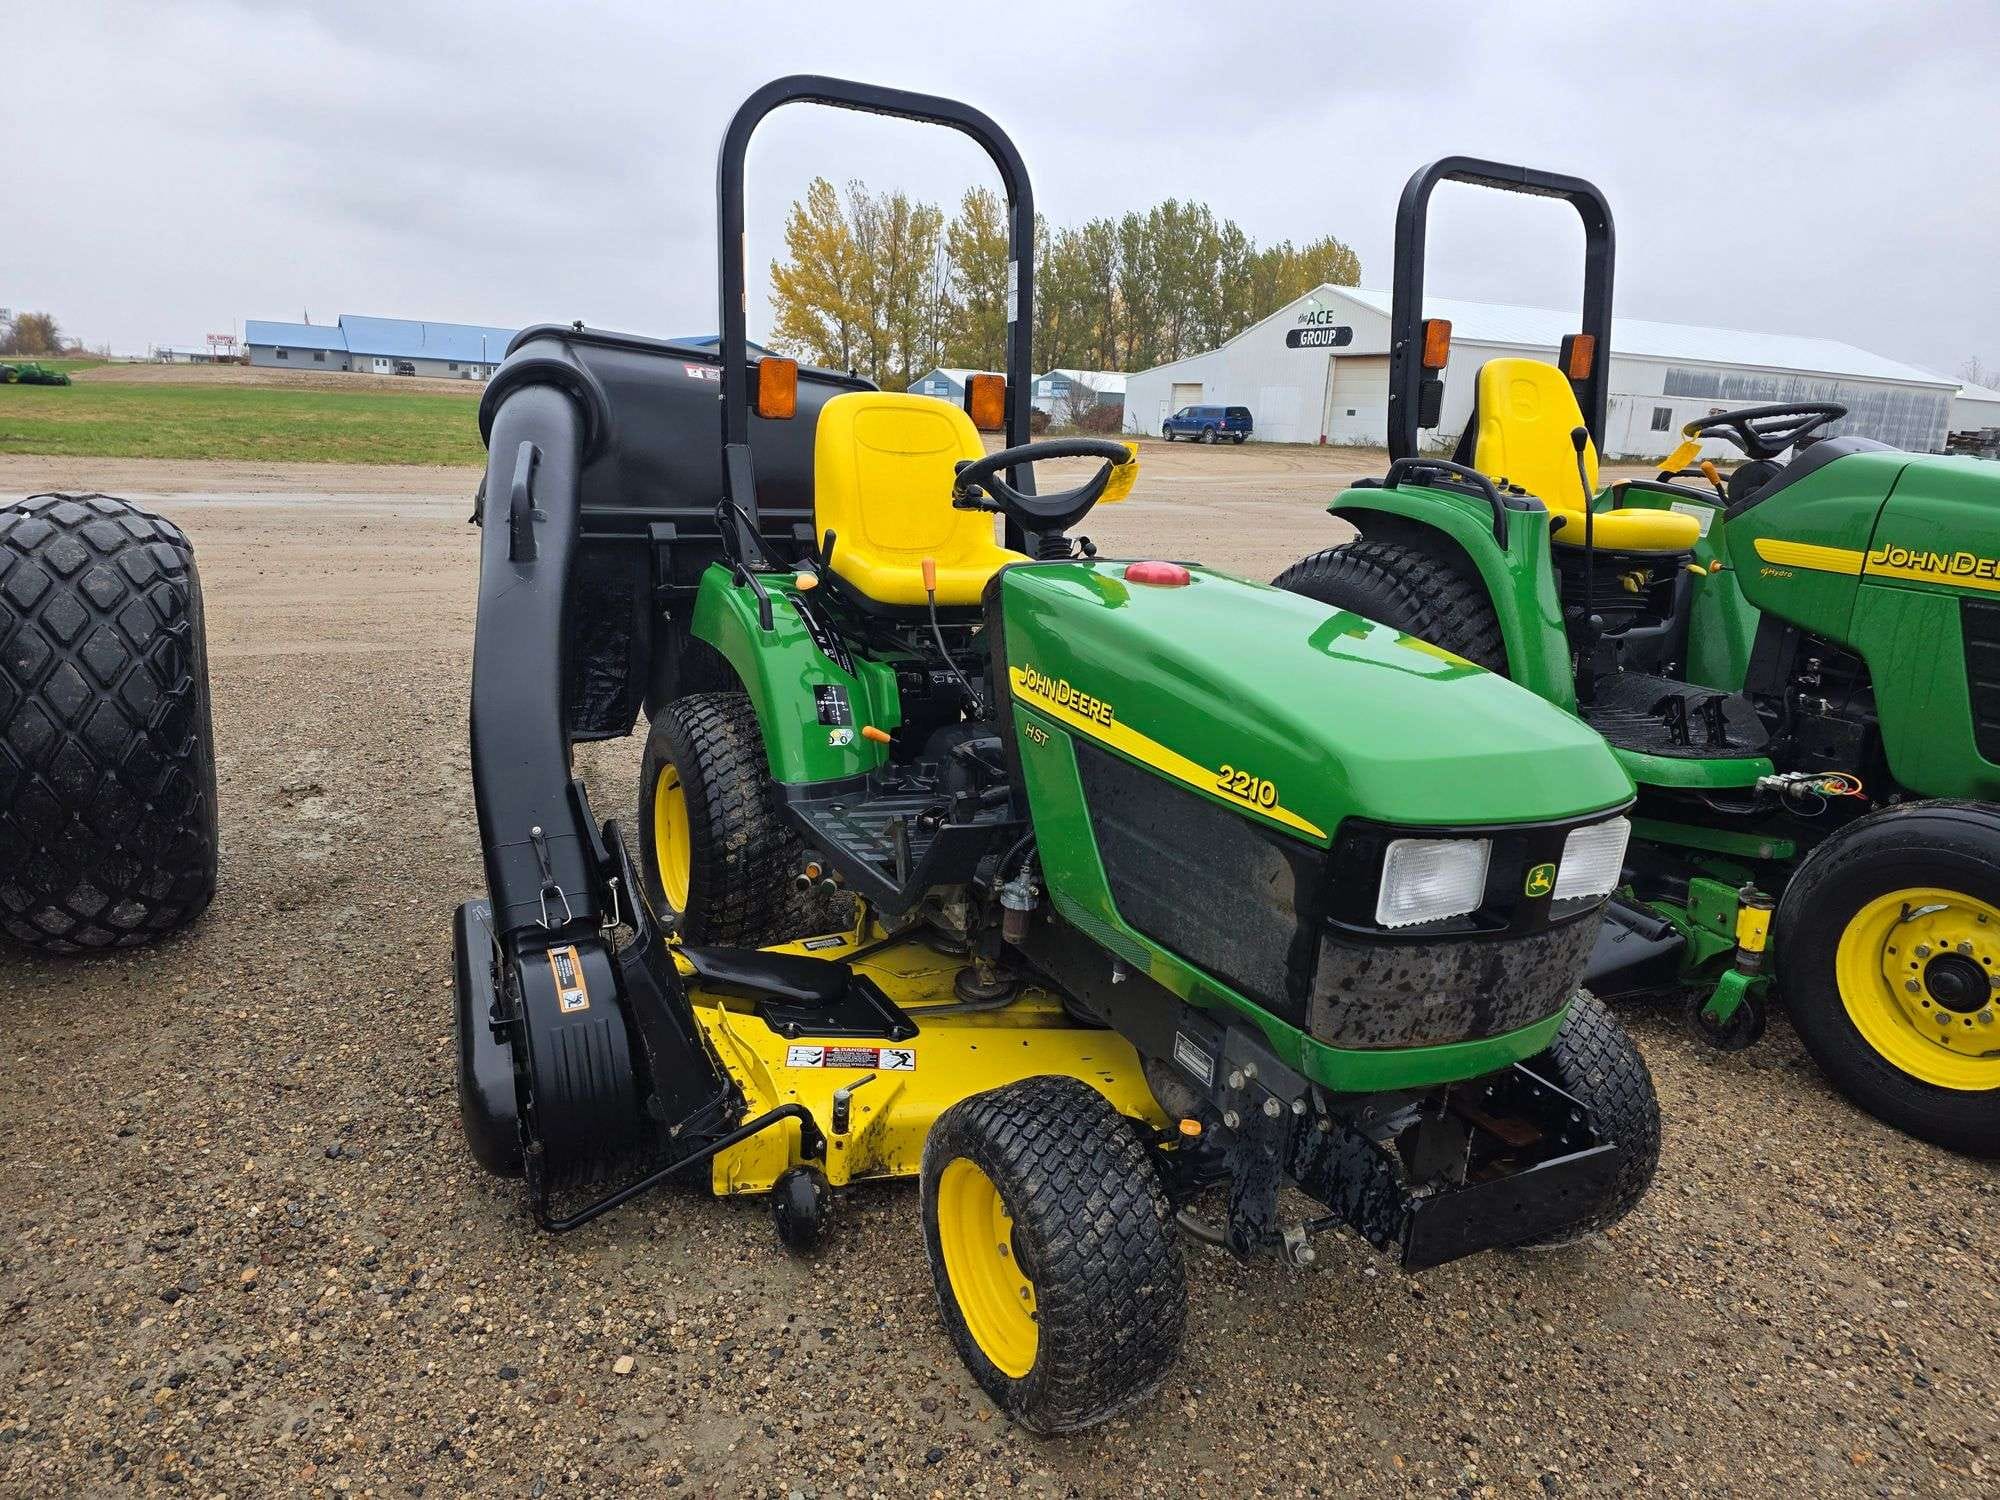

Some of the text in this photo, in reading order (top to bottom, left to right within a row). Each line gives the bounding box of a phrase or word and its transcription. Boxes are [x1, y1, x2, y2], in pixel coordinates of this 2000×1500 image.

[1307, 310, 1334, 326] ACE
[1300, 329, 1337, 346] GROUP
[1872, 543, 1950, 574] JOHN
[1020, 663, 1113, 727] JOHN DEERE
[1025, 722, 1050, 747] HST
[1217, 764, 1278, 809] 2210
